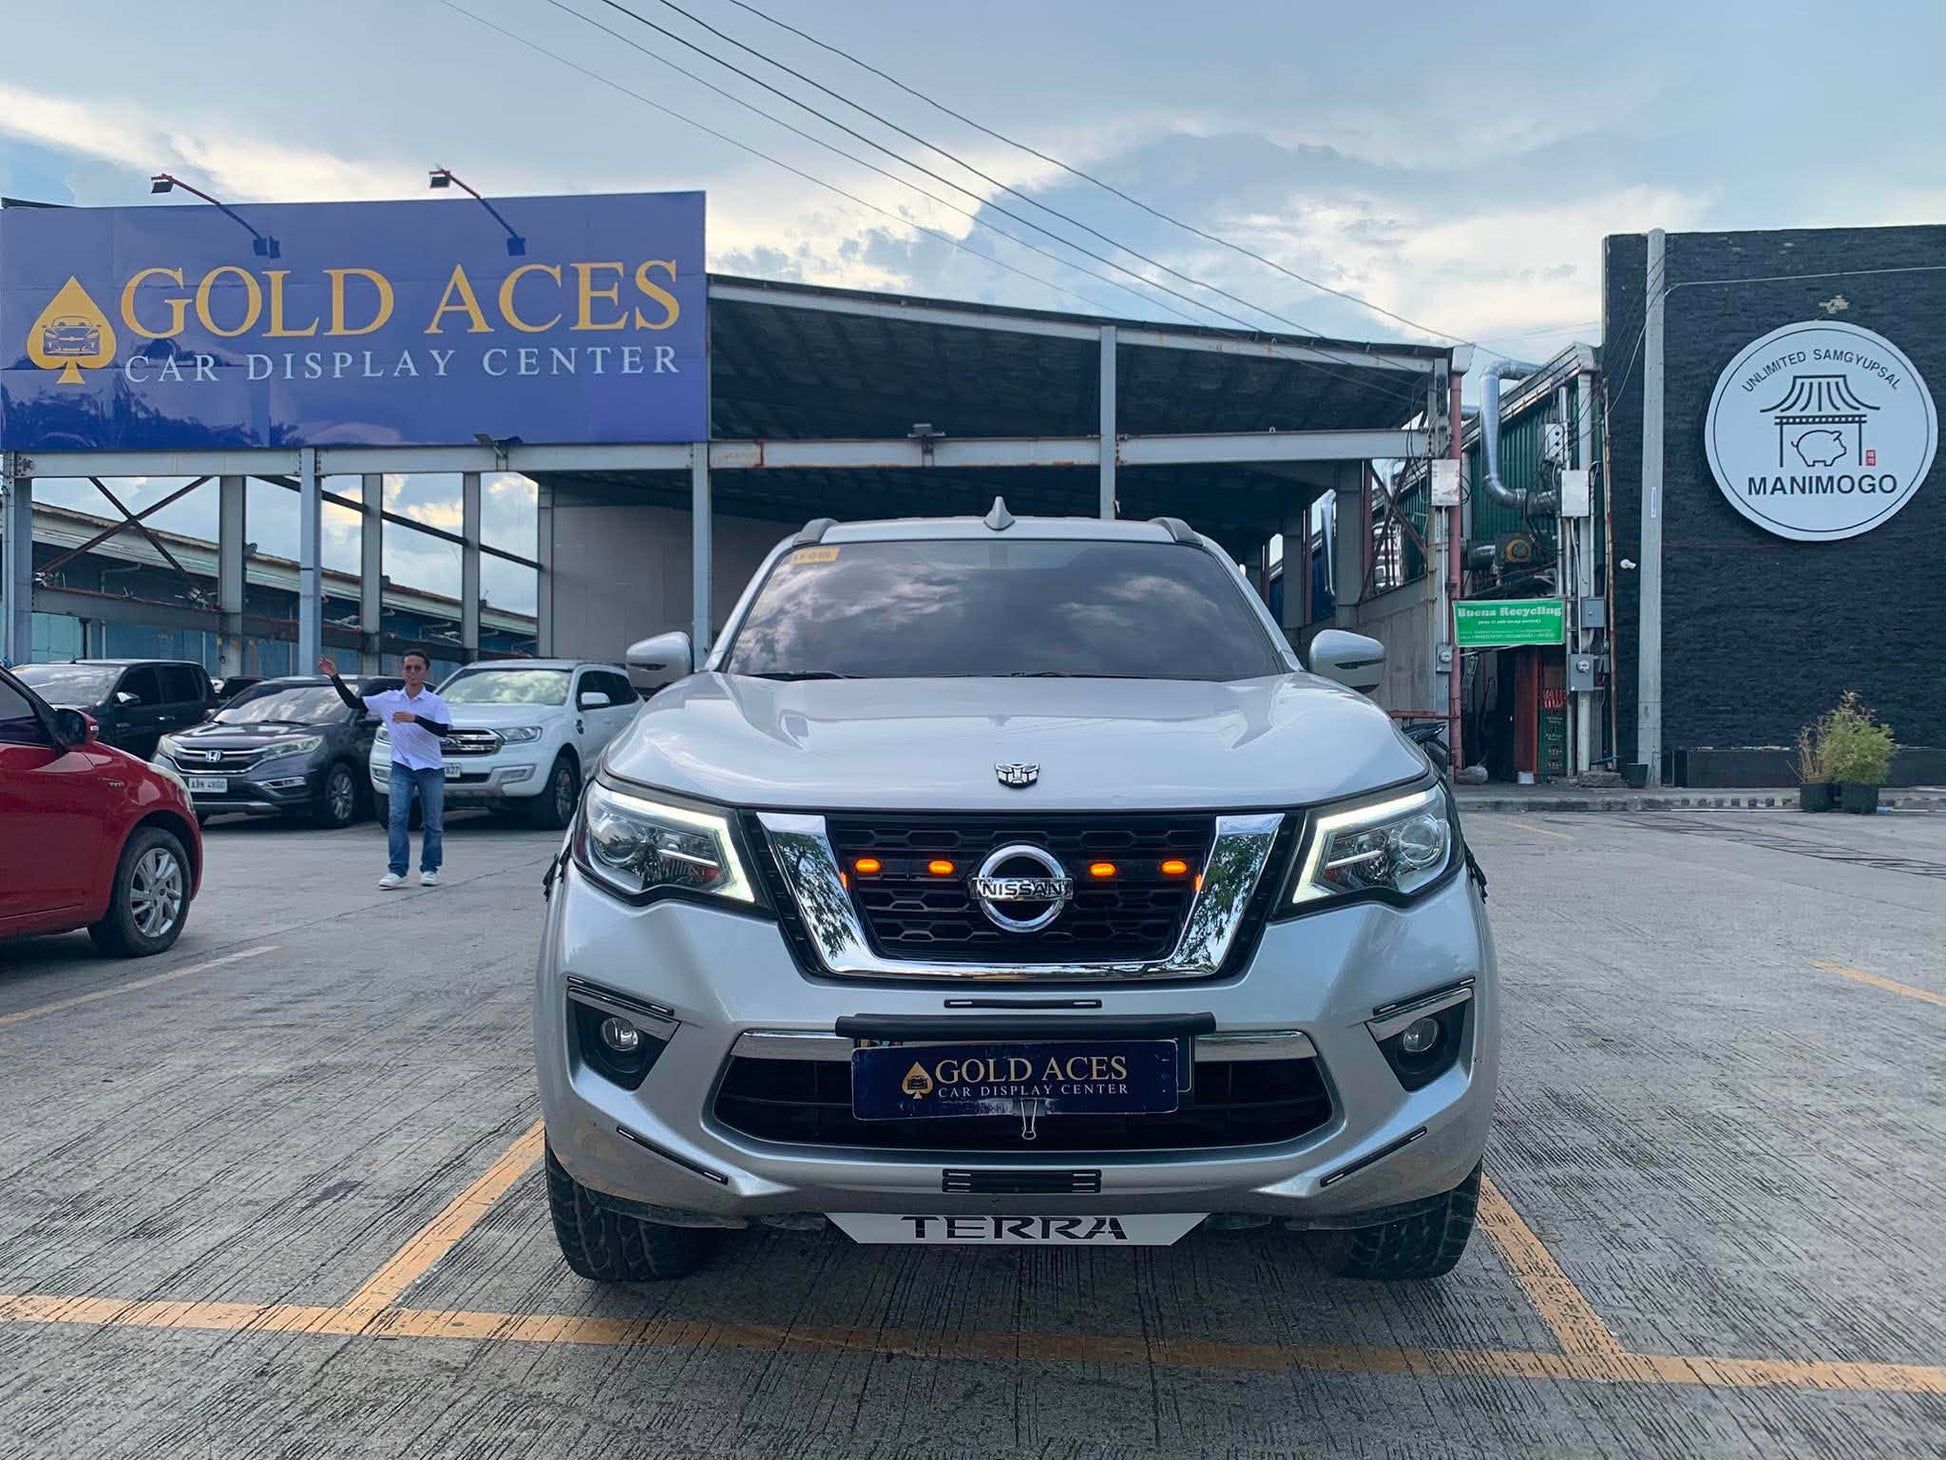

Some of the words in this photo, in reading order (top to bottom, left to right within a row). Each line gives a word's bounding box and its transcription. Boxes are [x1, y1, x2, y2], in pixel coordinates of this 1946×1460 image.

[120, 264, 394, 339] GOLD
[424, 259, 681, 335] ACES
[124, 353, 219, 383] CAR
[247, 349, 456, 381] DISPLAY
[482, 345, 681, 377] CENTER
[1742, 351, 1807, 393] UNLIMITED
[1813, 349, 1903, 390] SAMGYUPSAL
[1748, 474, 1898, 496] MANIMOGO
[1499, 606, 1562, 617] Recycling
[982, 883, 1062, 896] NISSAN
[935, 1058, 1033, 1084] GOLD
[1042, 1055, 1128, 1081] ACES
[938, 1086, 971, 1098] CAR
[981, 1084, 1052, 1096] DISPLAY
[1060, 1083, 1129, 1095] CENTER
[900, 1215, 1129, 1240] TERRA
